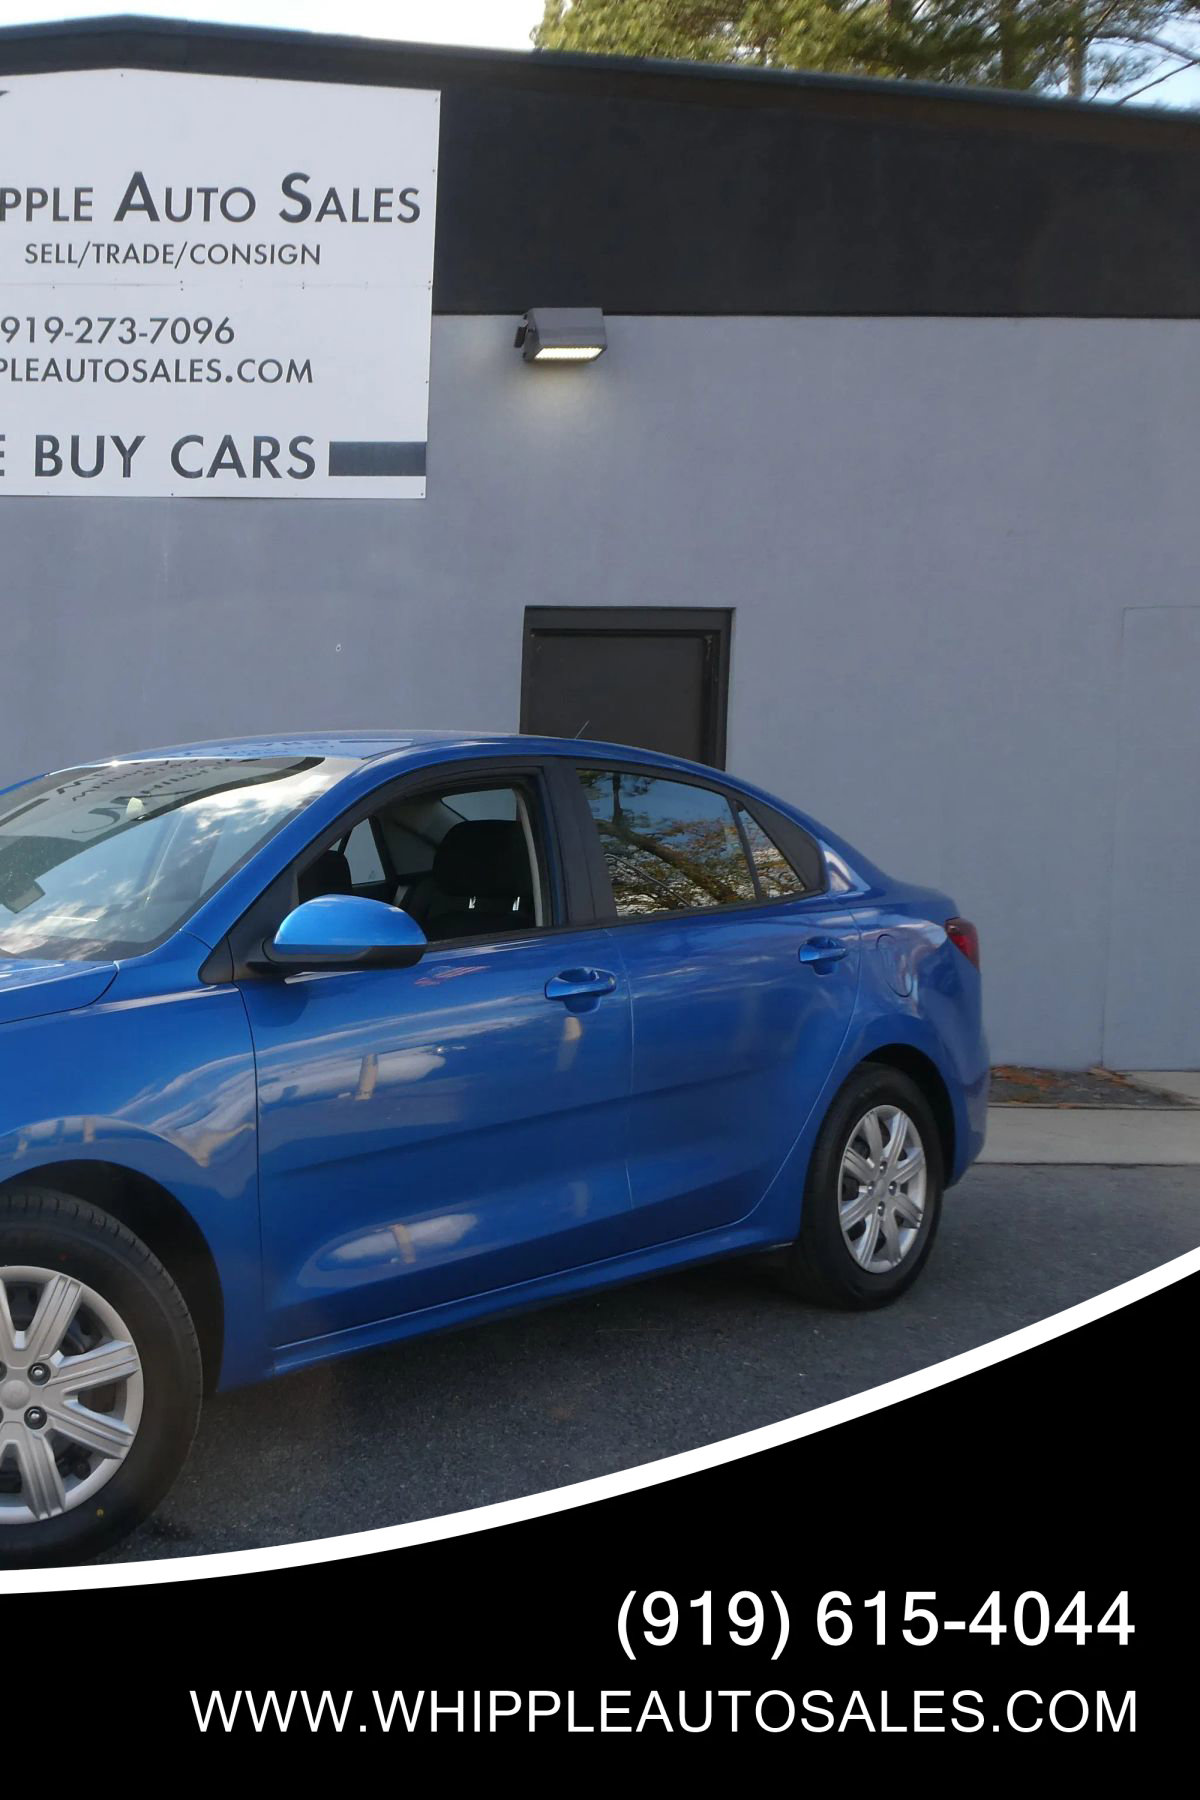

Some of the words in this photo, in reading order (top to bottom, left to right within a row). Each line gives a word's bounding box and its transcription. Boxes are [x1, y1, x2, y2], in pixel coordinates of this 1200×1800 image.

[113, 171, 256, 223] AUTO
[278, 172, 421, 224] SALES
[24, 241, 321, 269] SELL/TRADE/CONSIGN
[0, 316, 235, 345] 919-273-7096
[34, 434, 146, 479] BUY
[170, 434, 316, 480] CARS
